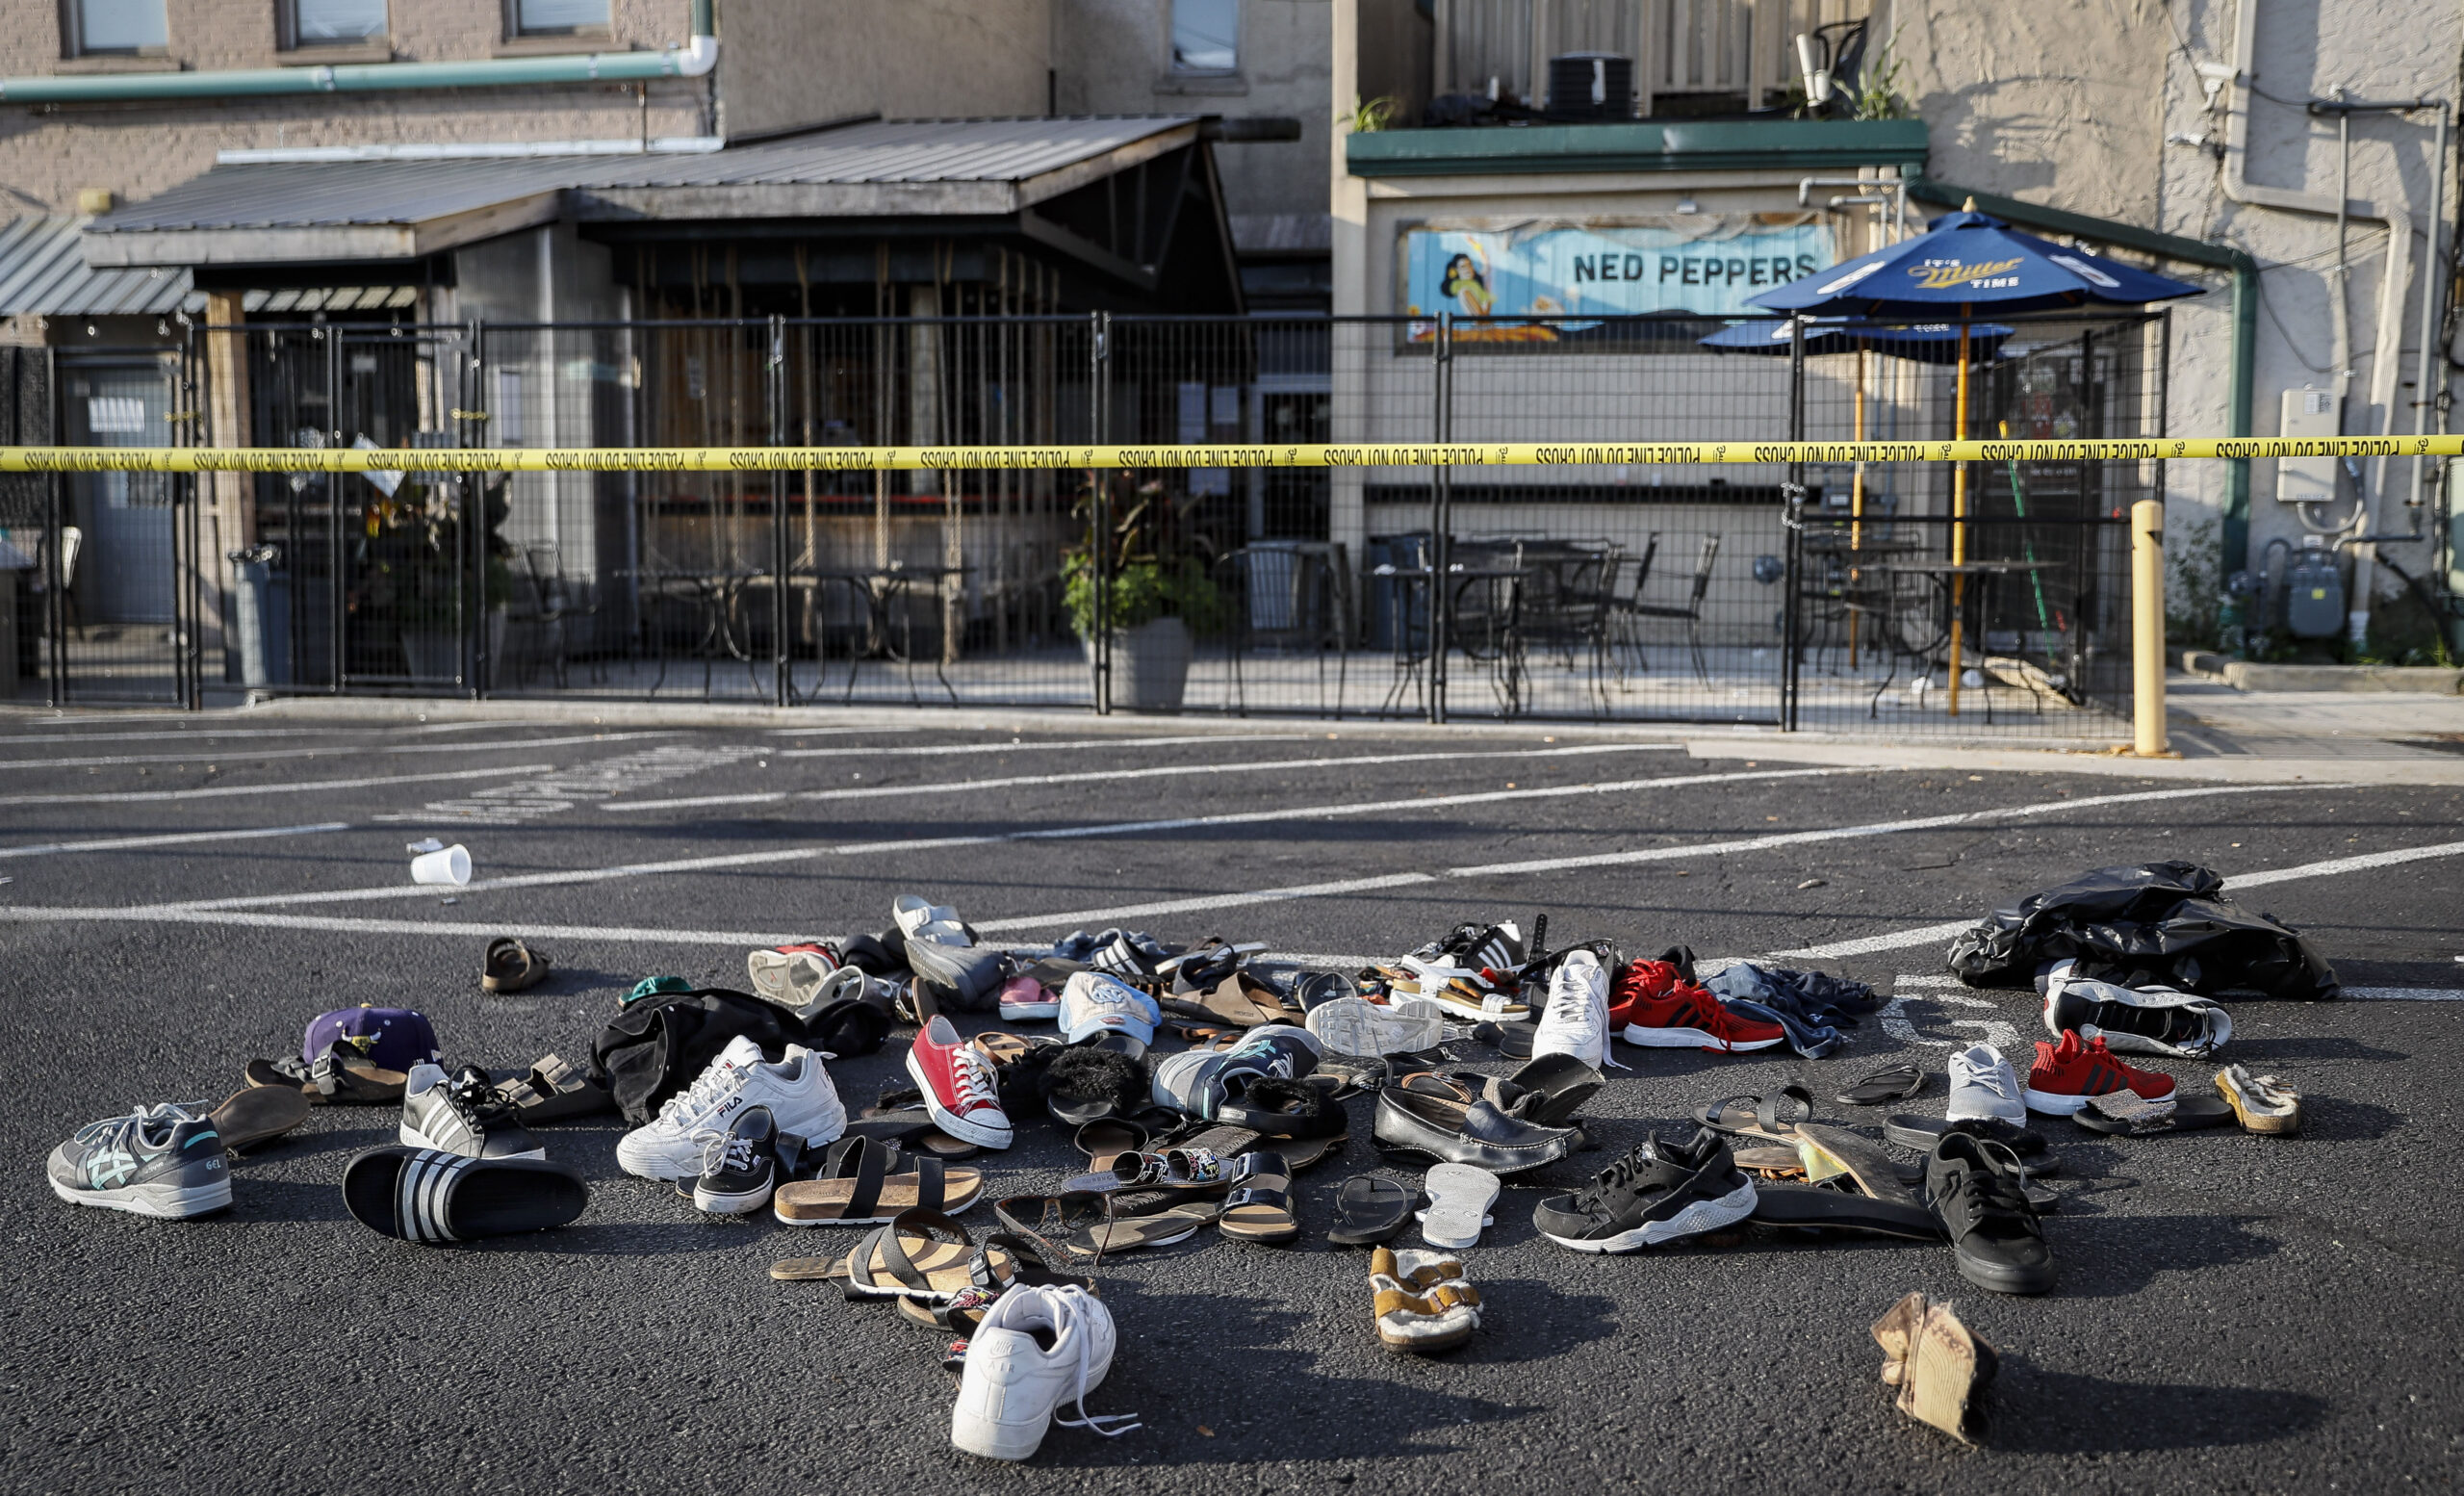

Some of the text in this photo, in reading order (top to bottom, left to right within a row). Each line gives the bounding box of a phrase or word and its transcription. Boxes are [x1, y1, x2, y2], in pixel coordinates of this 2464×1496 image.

[1575, 254, 1816, 285] NED PEPPERS
[1908, 256, 2025, 286] Miller
[1971, 276, 2019, 289] TIME
[1392, 448, 1409, 466] DO
[1412, 448, 1439, 466] LINE
[1441, 448, 1484, 465] POLICE
[1535, 447, 1577, 465] CROSS
[1606, 446, 1624, 464] DO
[1627, 446, 1655, 464] LINE
[1657, 446, 1701, 464] POLICE
[1754, 445, 1796, 463] CROSS
[1828, 444, 1846, 462] DO
[1848, 444, 1878, 462] LINE
[1880, 444, 1925, 462] POLICE
[1981, 443, 2025, 461] CROSS
[2057, 443, 2076, 460] DO
[2078, 442, 2109, 460] LINE
[2112, 442, 2159, 459] POLICE
[2216, 441, 2261, 458] CROSS
[2295, 441, 2315, 457] DO
[2318, 441, 2349, 457] LINE
[2351, 440, 2400, 456] POLICE
[545, 451, 579, 471] CROSS
[604, 451, 620, 471] DO
[622, 451, 646, 471] LINE
[648, 451, 685, 471] POLICE
[729, 451, 765, 470] CROSS
[790, 451, 807, 470] DO
[808, 451, 834, 470] LINE
[835, 451, 874, 470] POLICE
[920, 451, 958, 470] CROSS
[984, 450, 1001, 469] DO
[1003, 450, 1028, 469] LINE
[1030, 450, 1070, 469] POLICE
[1117, 450, 1157, 468] CROSS
[1185, 449, 1201, 468] DO
[1204, 449, 1230, 467] LINE
[1232, 449, 1273, 467] POLICE
[1322, 449, 1363, 466] CROSS
[717, 1096, 743, 1118] FILA
[205, 1158, 221, 1171] GEL
[988, 1360, 1015, 1374] AIR
